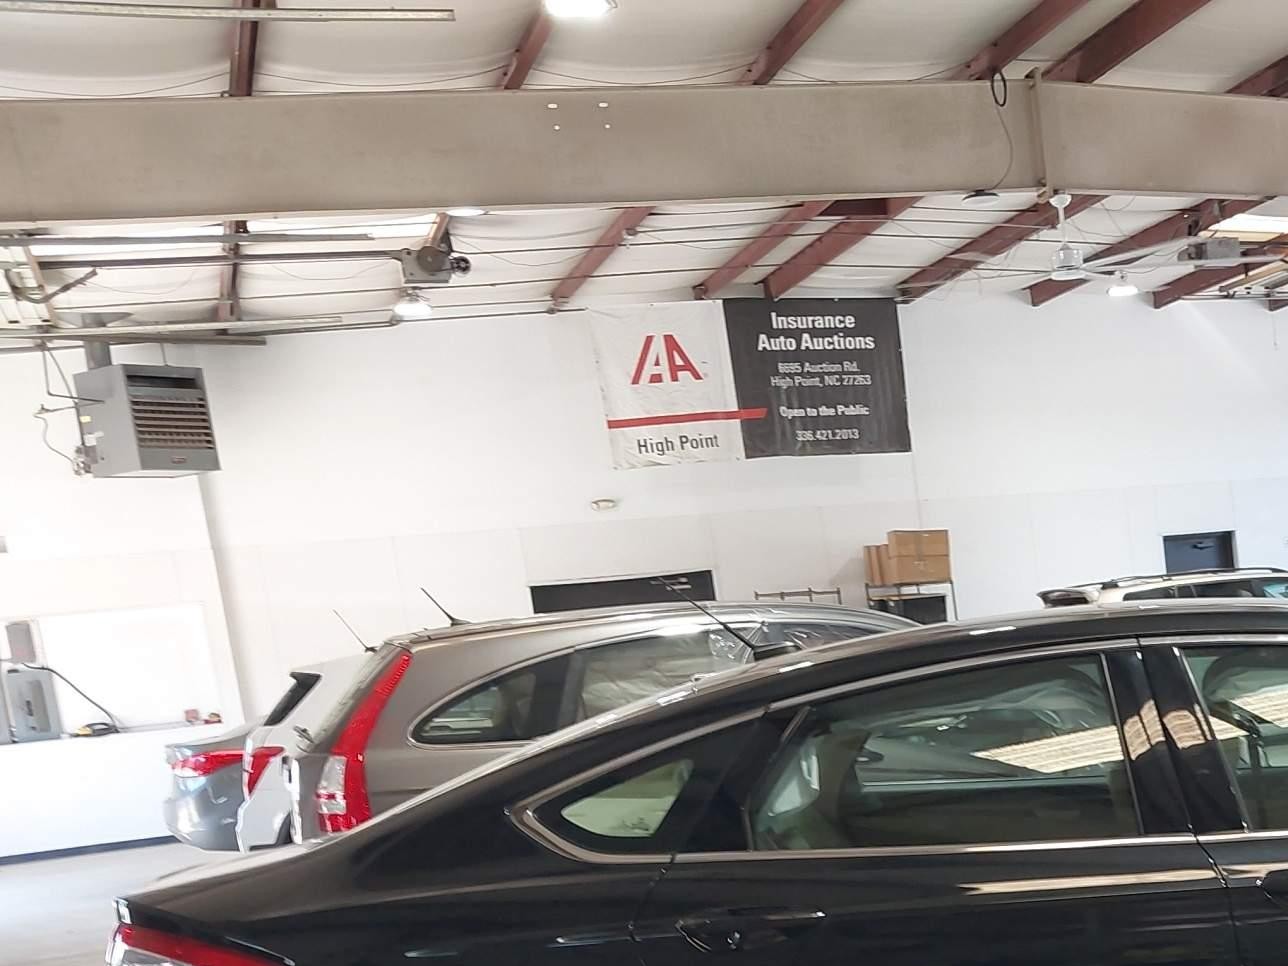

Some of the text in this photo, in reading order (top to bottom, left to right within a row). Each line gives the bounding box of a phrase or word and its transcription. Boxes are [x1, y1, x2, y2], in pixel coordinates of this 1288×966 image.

[770, 311, 856, 329] Insurance
[757, 332, 875, 351] Auto Auctions
[803, 361, 842, 372] Auction
[770, 375, 794, 389] High
[824, 375, 841, 386] NC
[780, 404, 870, 420] Open to the Public
[637, 433, 720, 456] High Point
